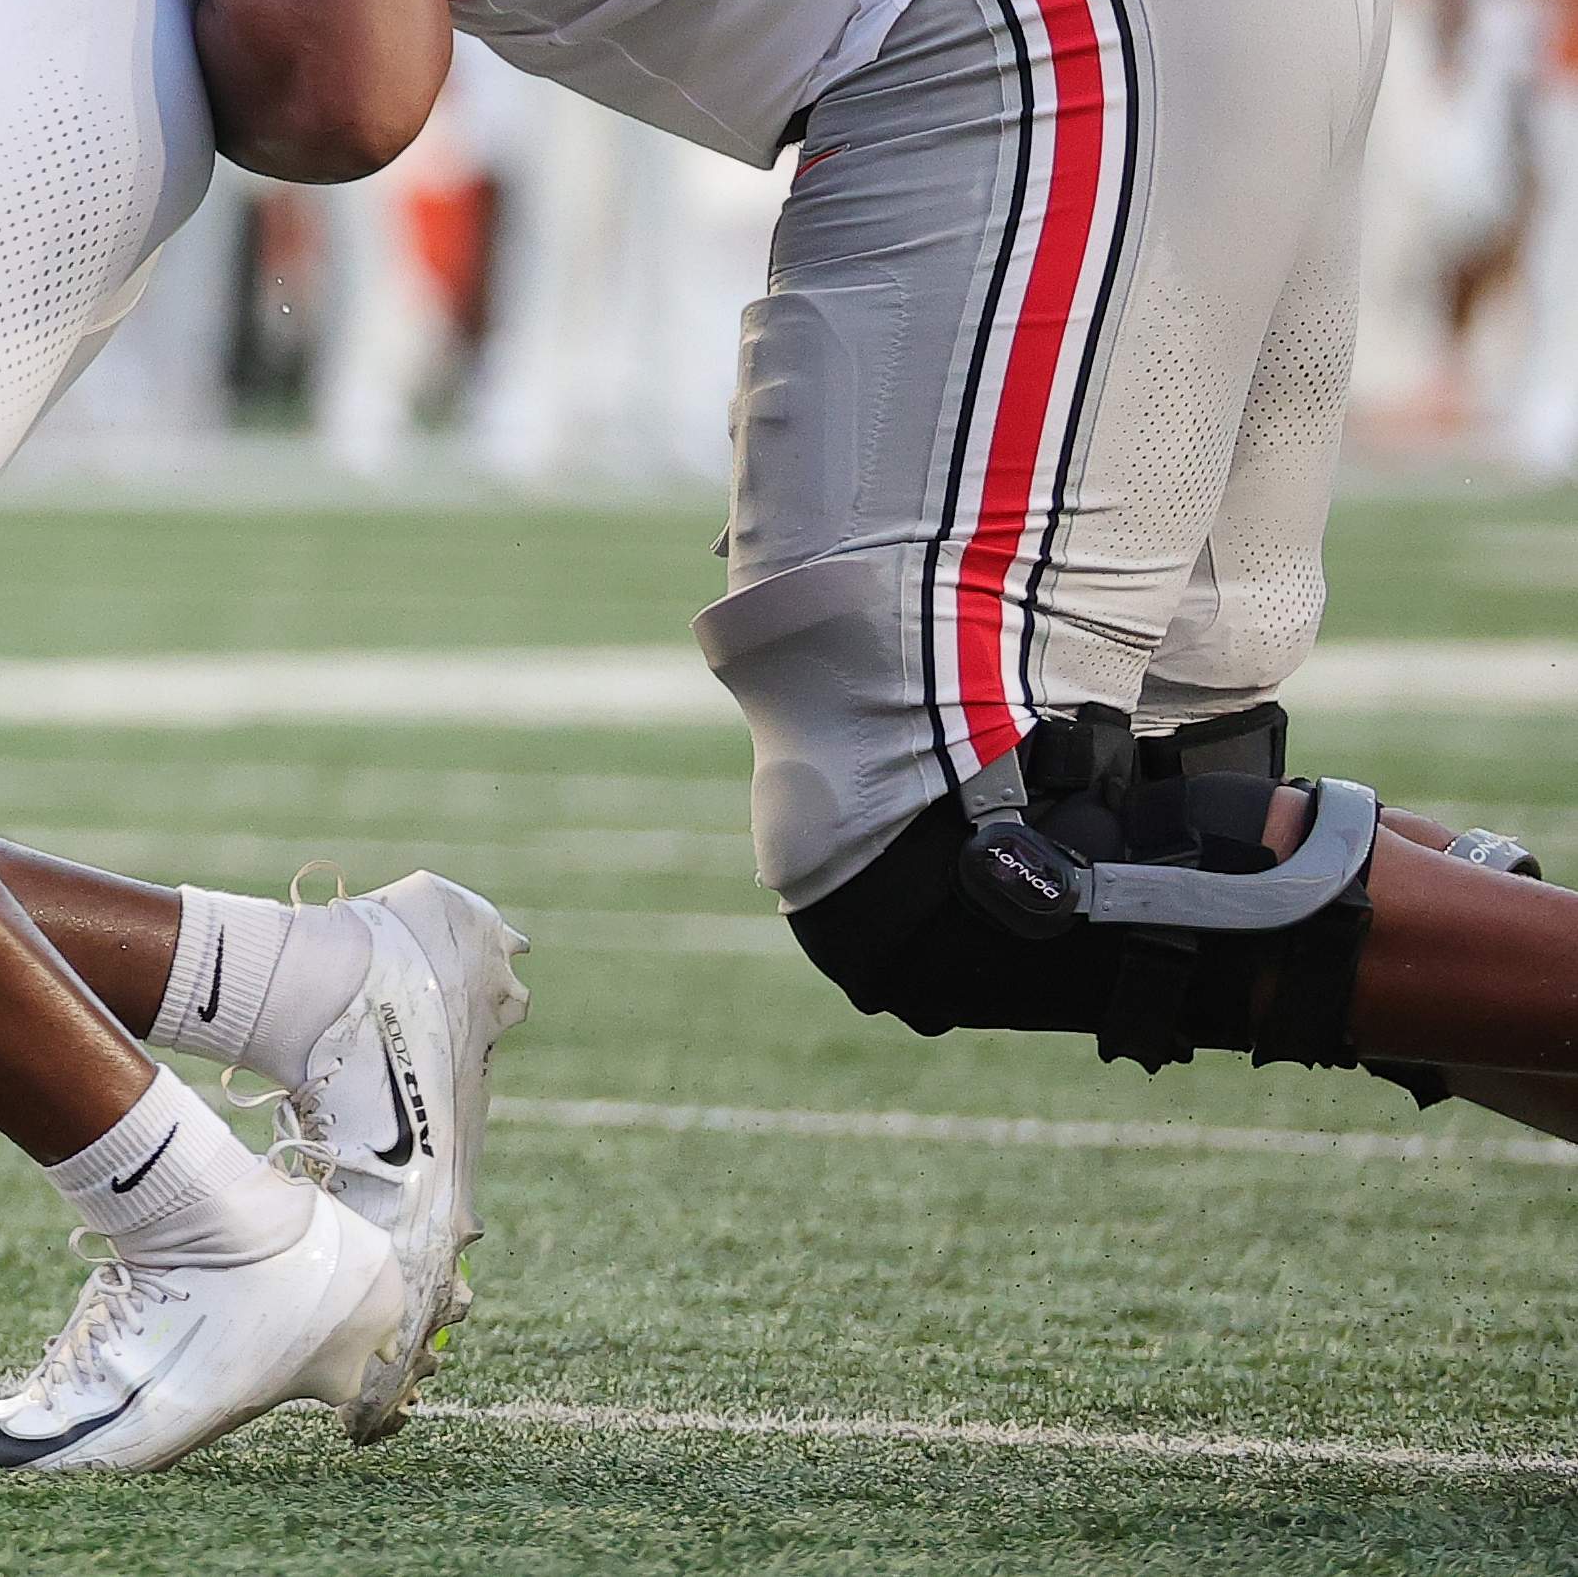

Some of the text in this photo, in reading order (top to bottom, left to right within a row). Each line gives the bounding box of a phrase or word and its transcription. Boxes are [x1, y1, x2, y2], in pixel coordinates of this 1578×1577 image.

[987, 846, 1060, 900] DONJOY
[379, 1001, 435, 1159] AIR ZOOM
